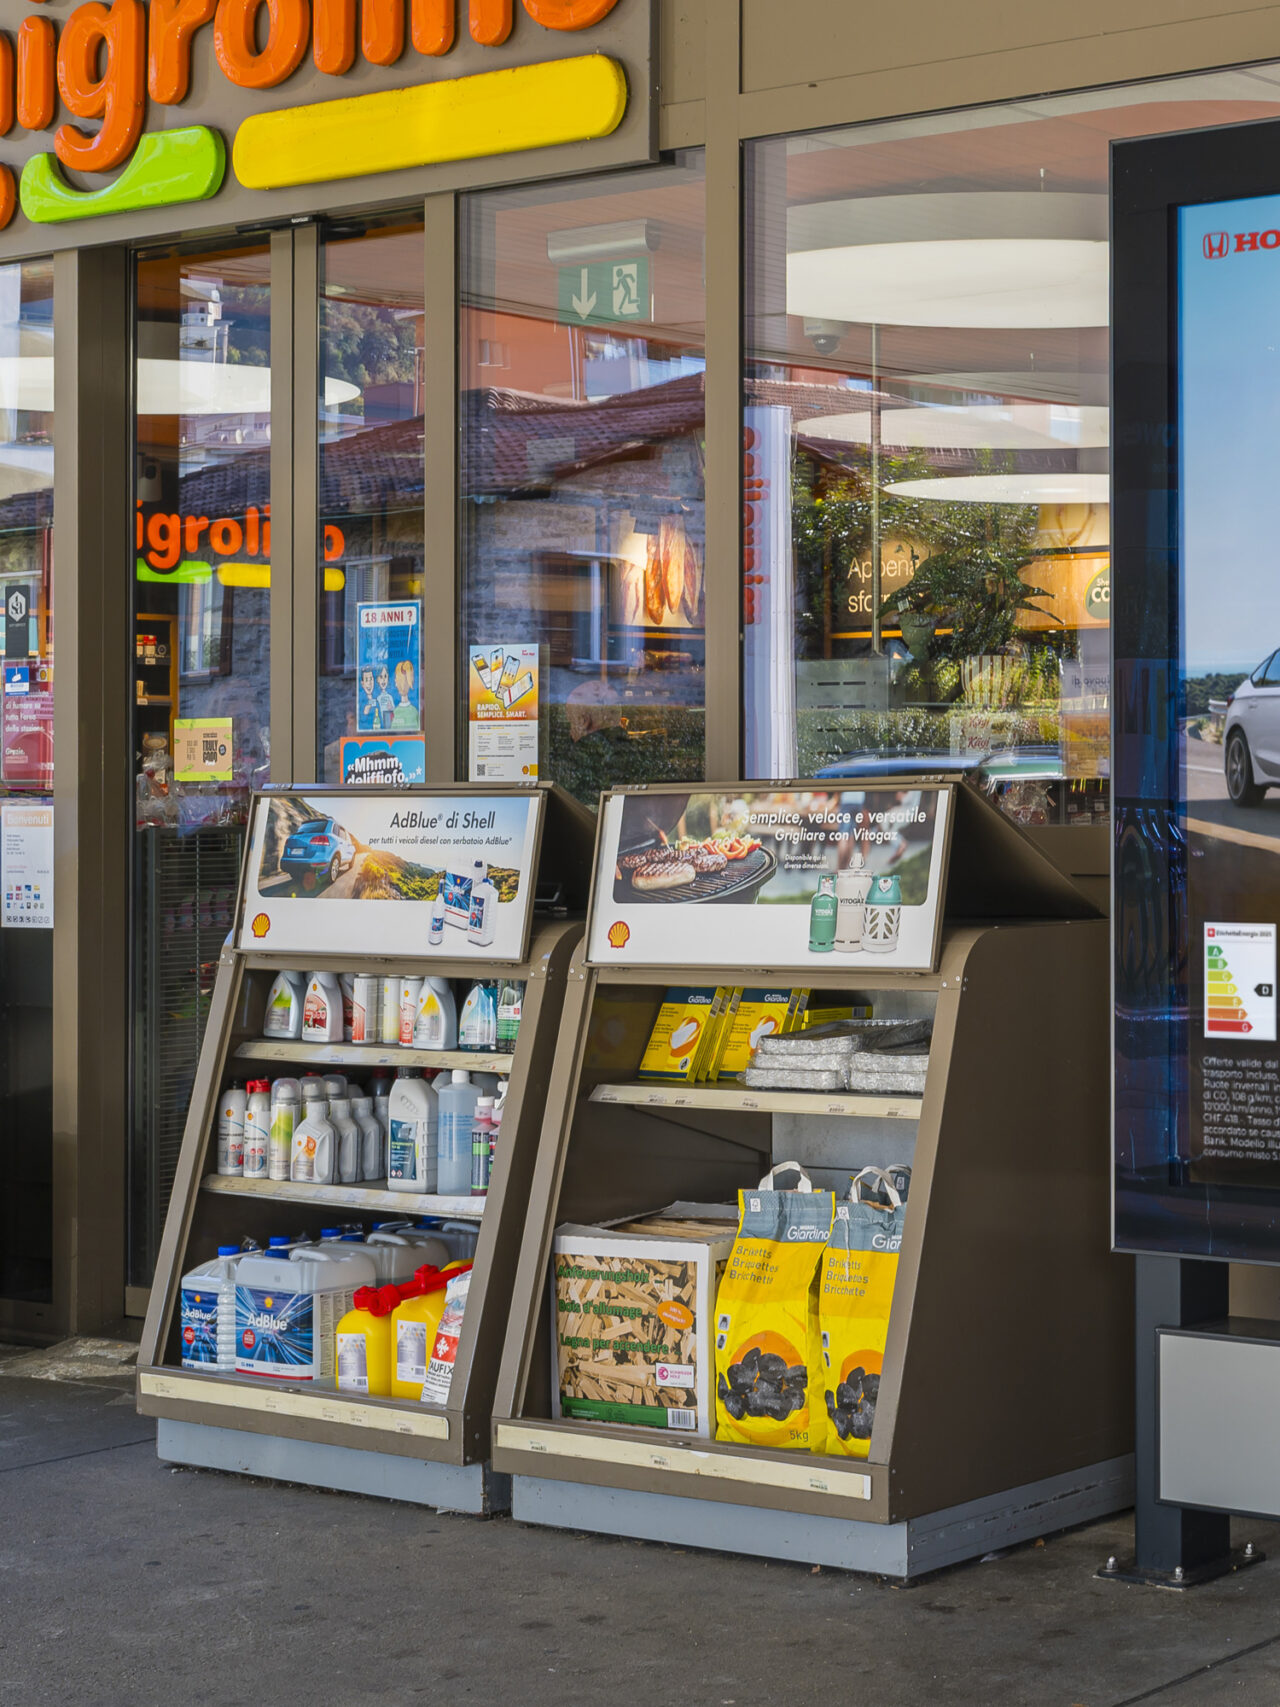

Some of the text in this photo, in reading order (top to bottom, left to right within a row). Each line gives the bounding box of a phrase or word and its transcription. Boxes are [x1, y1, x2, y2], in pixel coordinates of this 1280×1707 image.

[365, 612, 377, 623] 18
[380, 611, 404, 623] ANNI
[477, 703, 501, 711] RAPIDO.
[477, 710, 528, 719] SEMPLICE. SMART.
[7, 813, 49, 825] Benvenuti
[446, 811, 460, 828] di
[462, 810, 496, 829] Shell
[741, 807, 927, 828] Semplice, veloce e versatile
[369, 838, 379, 847] per
[381, 837, 394, 845] tutti
[399, 836, 419, 845] veicoli
[420, 836, 438, 845] diesel
[452, 837, 484, 845] serbatoio
[775, 828, 898, 845] Grigliare con Vitogaz
[784, 853, 812, 862] Disponibile
[840, 897, 865, 905] VITOGAZ
[1212, 948, 1220, 957] A
[1218, 959, 1224, 969] B
[1228, 984, 1234, 994] D
[1262, 986, 1269, 995] D
[1233, 998, 1238, 1008] E
[1238, 1010, 1243, 1019] F
[1242, 1023, 1248, 1032] G
[787, 1225, 830, 1240] Giardino
[736, 1245, 773, 1259] Briketts
[732, 1257, 779, 1273] Briquettes
[828, 1257, 862, 1270] Briketts
[557, 1265, 650, 1285] Anfeuerungsholz
[824, 1283, 866, 1297] Bricchette
[558, 1299, 642, 1320] Bois d'allumage
[560, 1333, 669, 1354] Legna per accendere
[789, 1430, 809, 1442] 5kg
